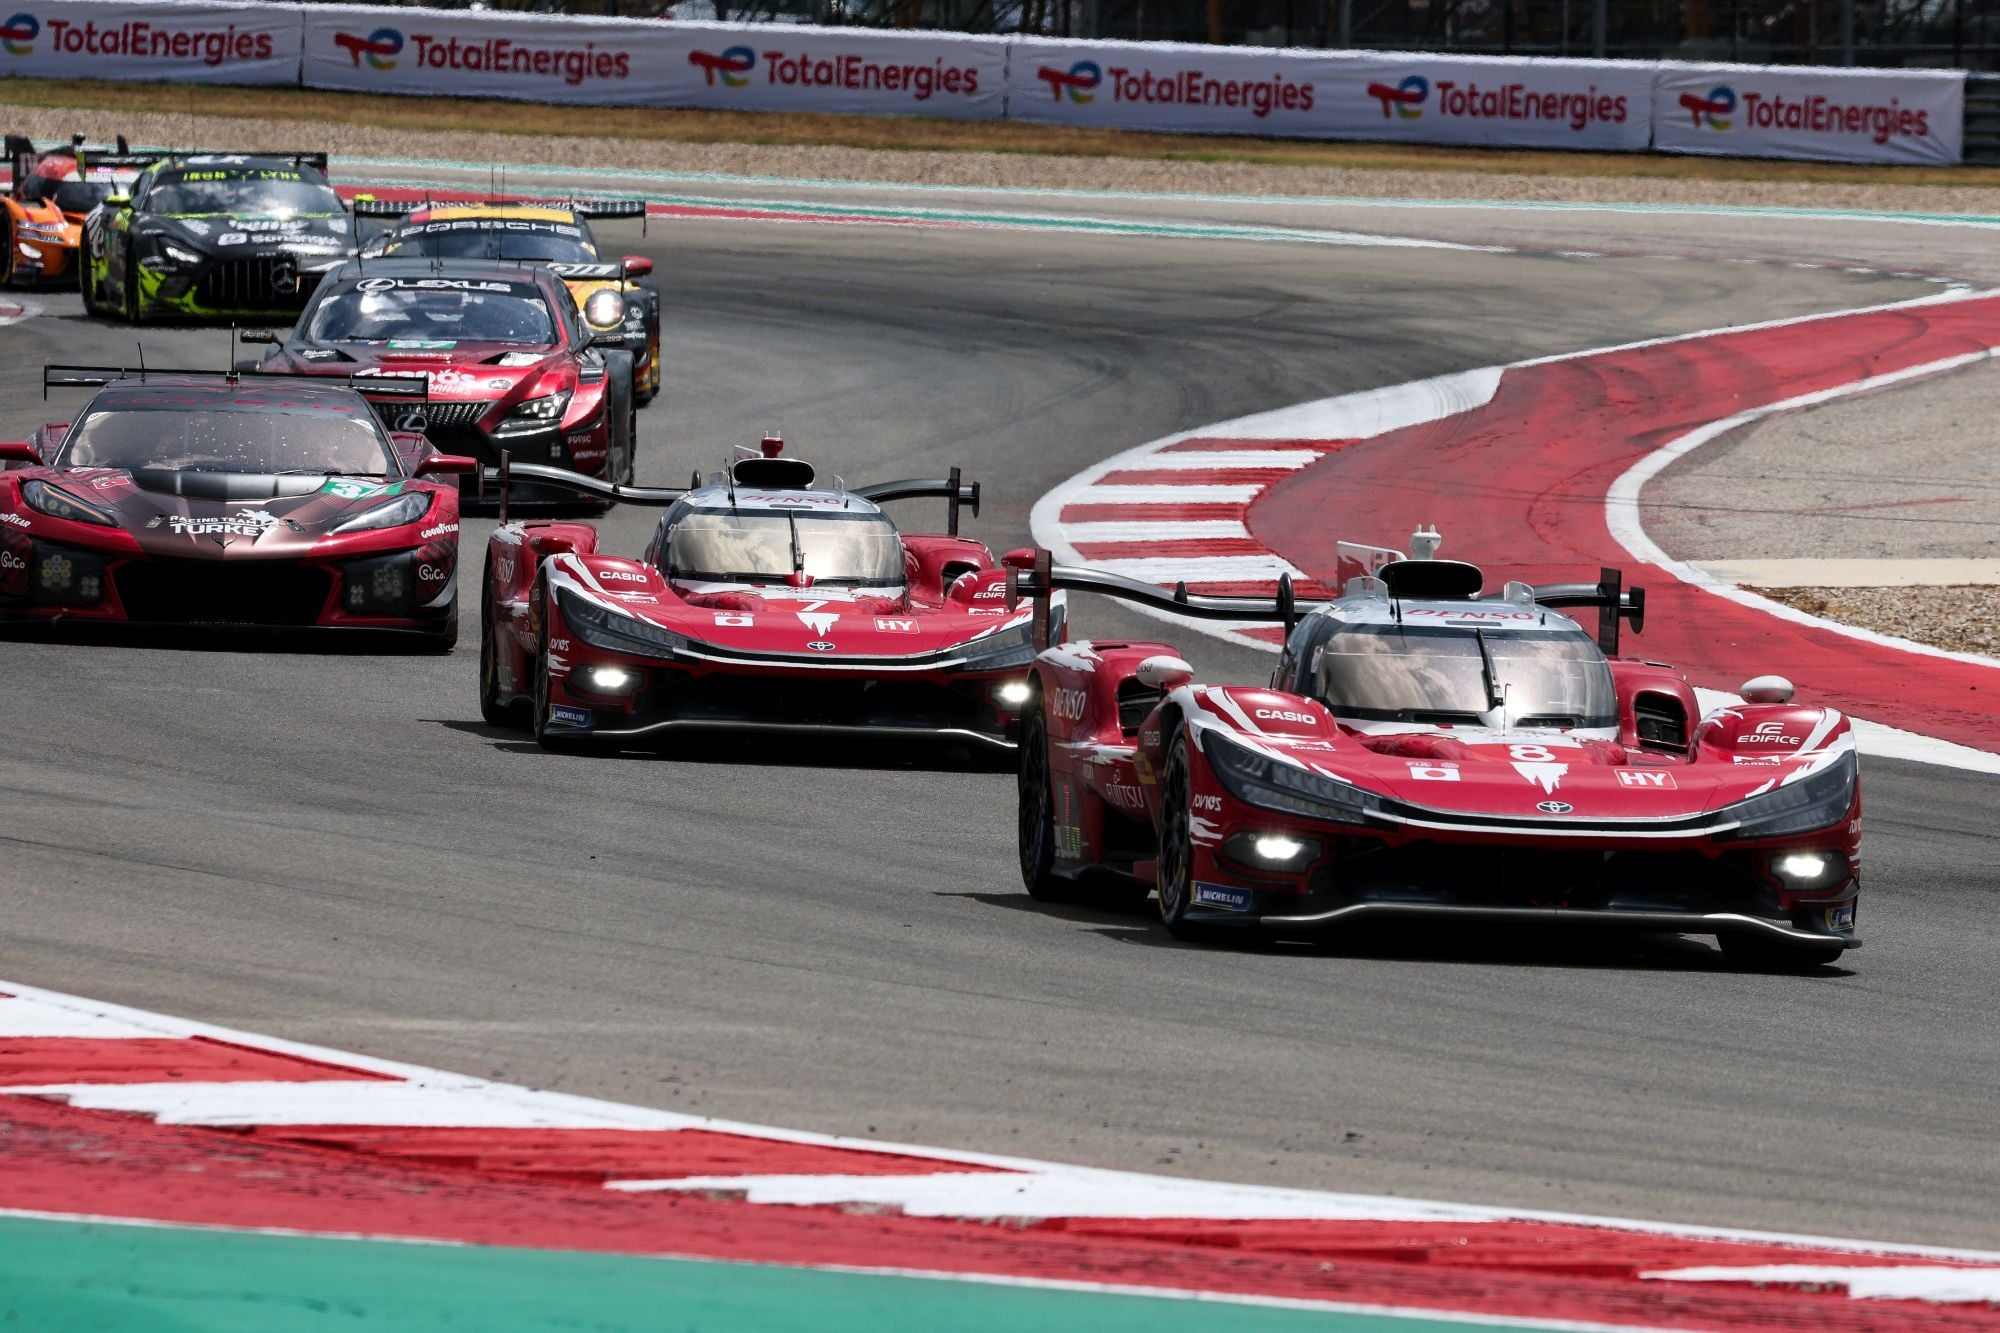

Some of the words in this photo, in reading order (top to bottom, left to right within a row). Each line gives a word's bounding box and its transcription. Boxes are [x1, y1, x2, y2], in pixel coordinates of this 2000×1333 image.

[48, 20, 273, 66] TotalEnergies
[411, 34, 630, 85] TotalEnergies
[763, 51, 979, 100] TotalEnergies
[1109, 67, 1314, 118] TotalEnergies
[1436, 81, 1627, 131] TotalEnergies
[1743, 92, 1928, 144] TotalEnergies
[401, 222, 582, 239] PORSCHE
[397, 279, 512, 293] LEXUS
[740, 495, 842, 506] DENSO
[221, 517, 257, 525] TEAM
[170, 523, 278, 537] TURKEY
[421, 523, 459, 538] GOODYEAR
[600, 571, 648, 583] CASIO
[797, 600, 829, 611] 7
[1405, 608, 1535, 620] DENSO
[878, 619, 914, 631] HY
[1053, 688, 1087, 721] DENSO
[1255, 708, 1317, 725] CASIO
[1737, 734, 1801, 745] EDIFICE
[1510, 744, 1557, 762] 8
[1620, 771, 1667, 786] HY
[1203, 891, 1244, 905] MICHELIN
